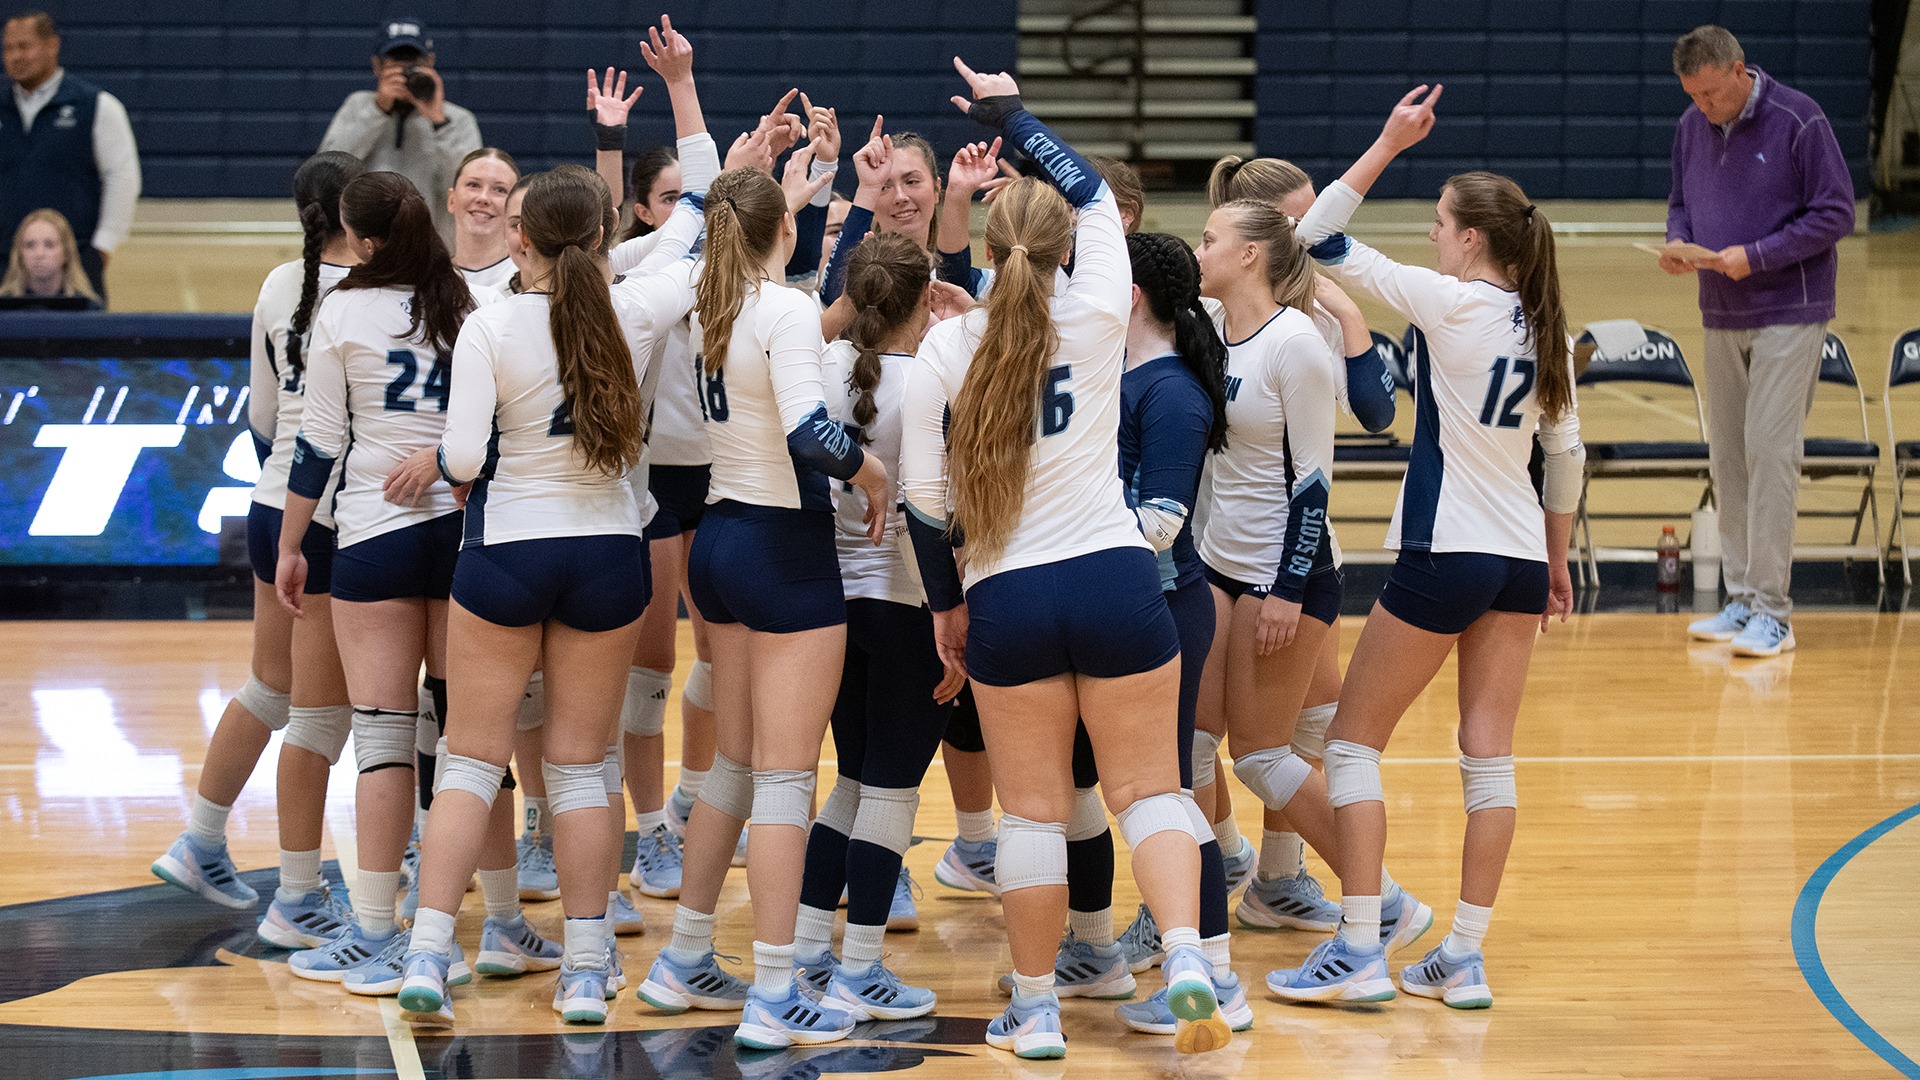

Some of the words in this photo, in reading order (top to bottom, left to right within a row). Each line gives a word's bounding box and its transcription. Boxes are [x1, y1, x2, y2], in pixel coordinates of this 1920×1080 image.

[1044, 152, 1087, 193] MATT
[383, 349, 450, 413] 24
[1479, 355, 1536, 429] 12
[1295, 506, 1325, 556] SCOTS
[1288, 554, 1313, 577] GO
